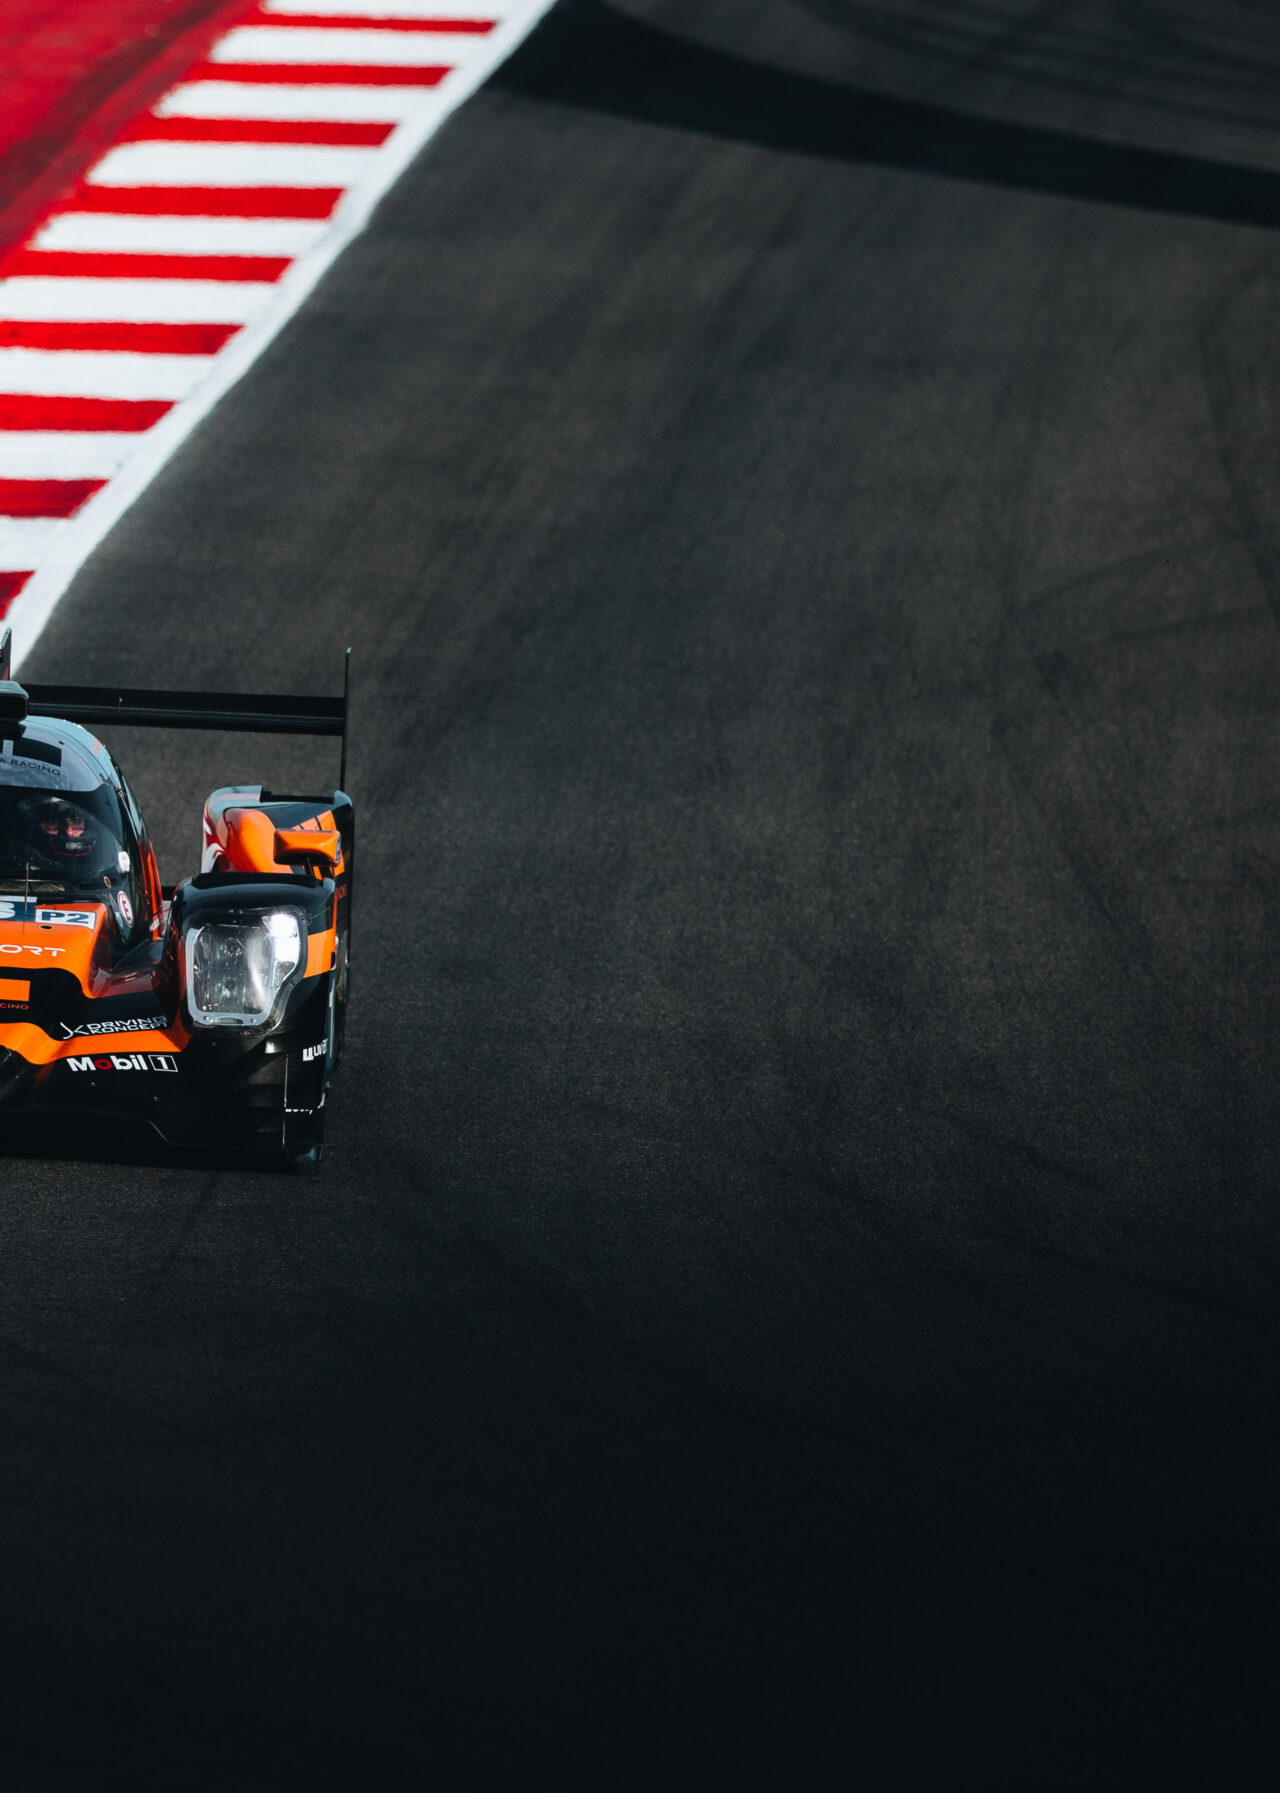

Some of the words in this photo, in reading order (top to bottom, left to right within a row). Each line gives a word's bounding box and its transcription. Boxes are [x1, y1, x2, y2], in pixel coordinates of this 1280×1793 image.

[10, 758, 61, 776] RACING
[41, 911, 90, 925] P2
[86, 1015, 167, 1030] DRIVING
[90, 1021, 169, 1035] KONCEPT
[66, 1054, 148, 1072] Mobil
